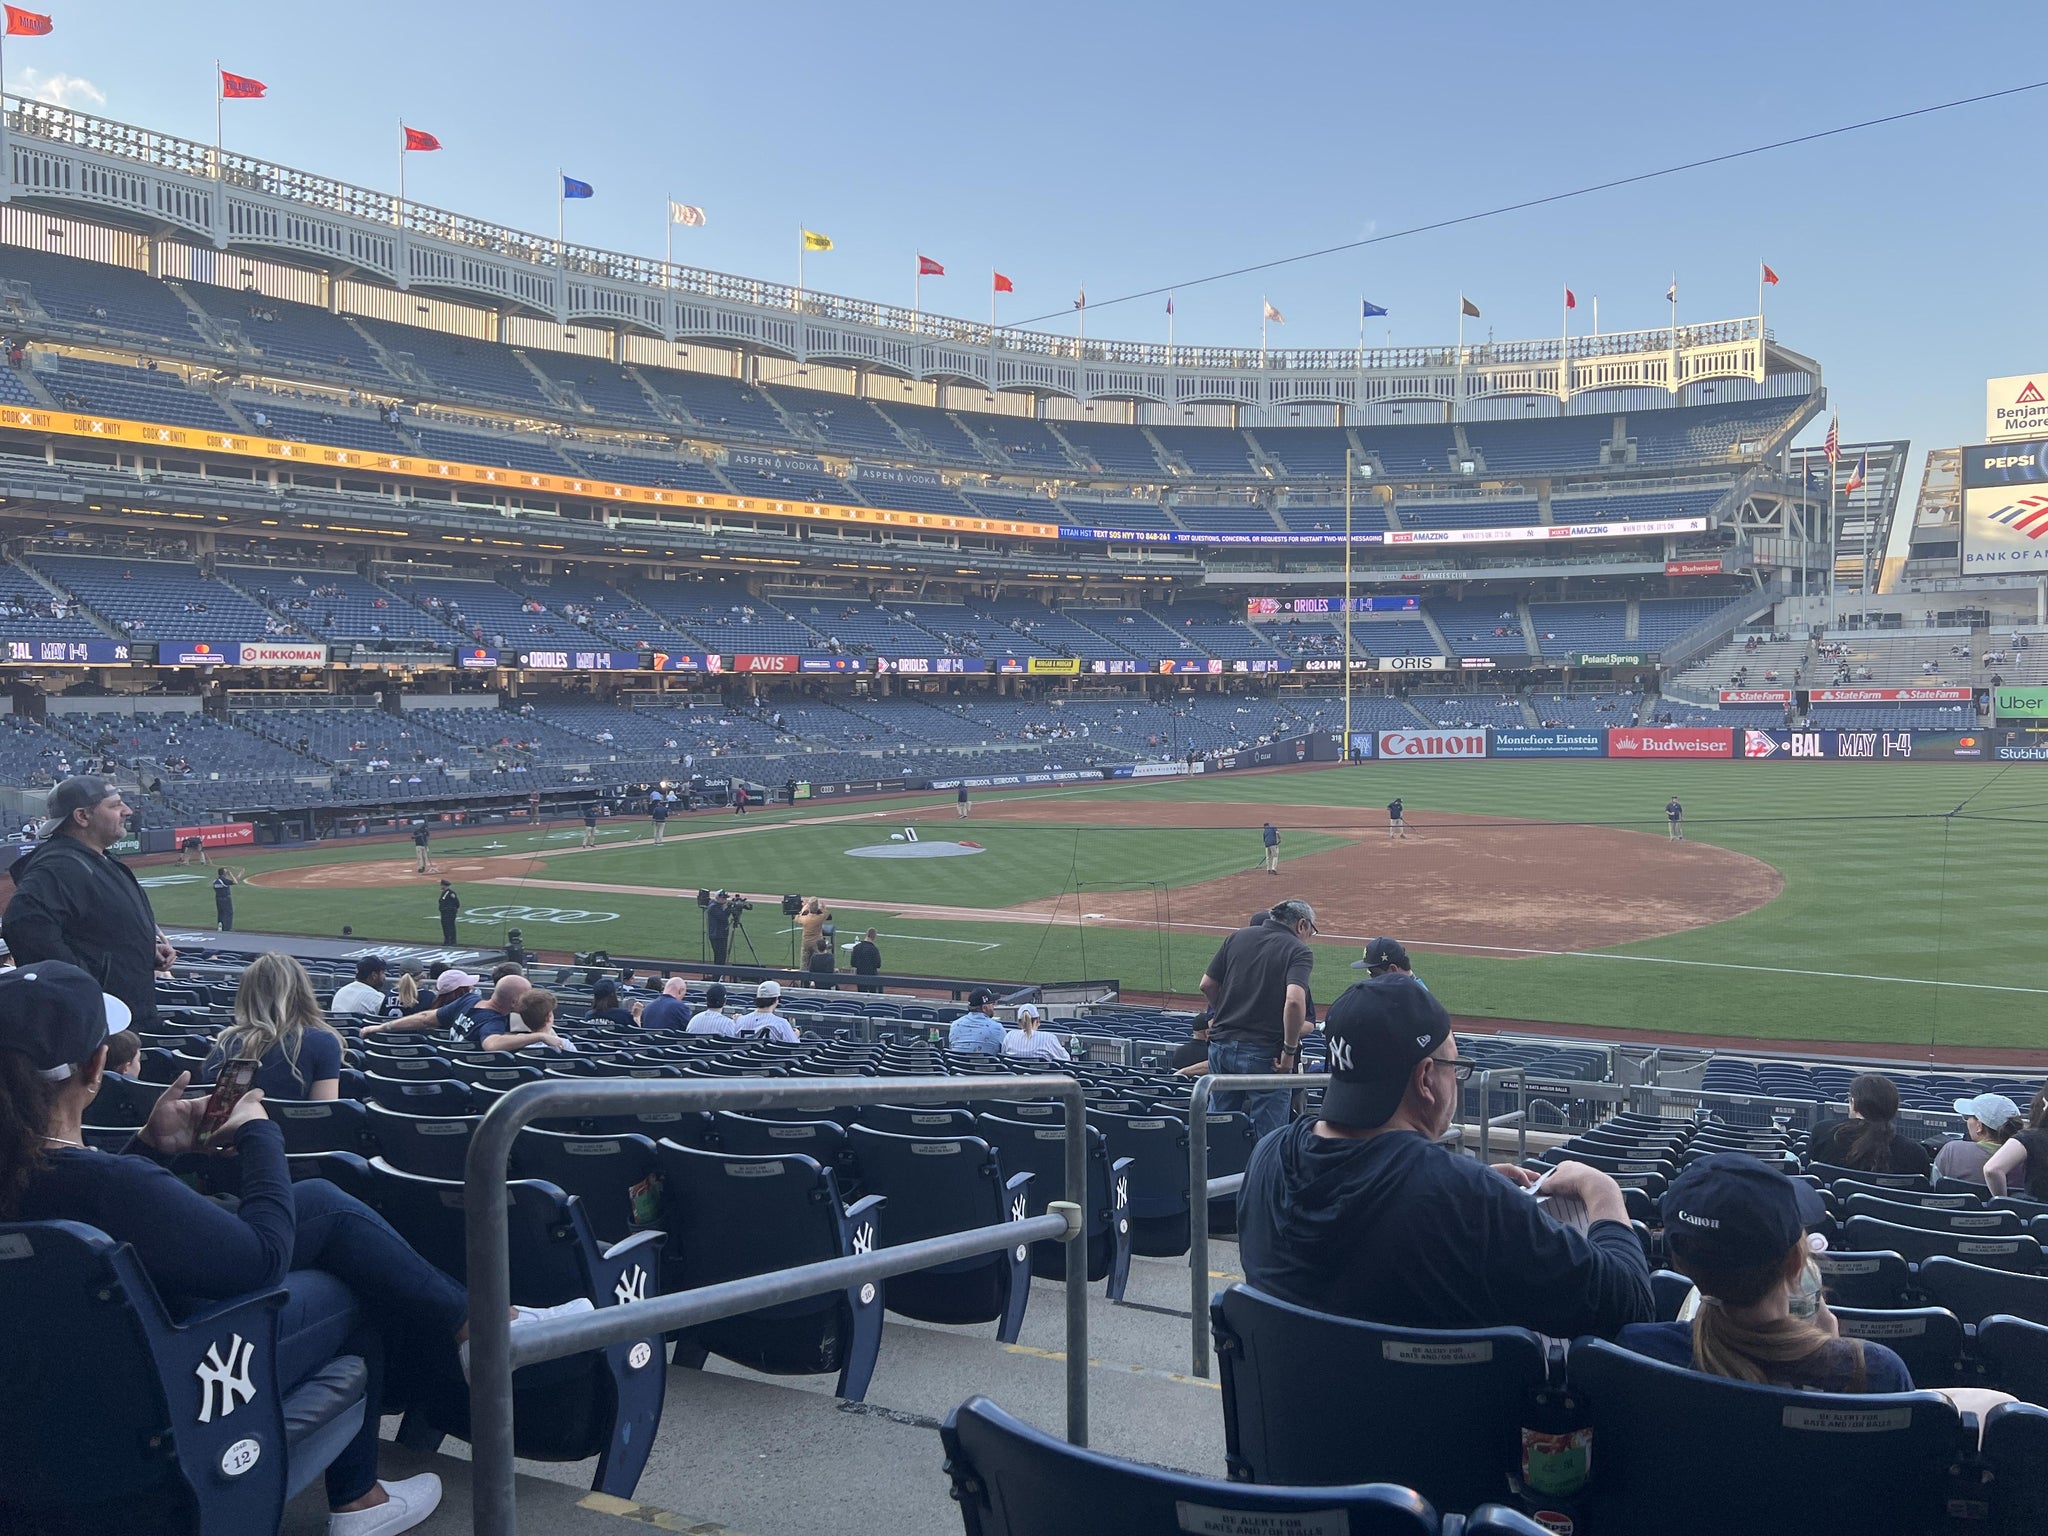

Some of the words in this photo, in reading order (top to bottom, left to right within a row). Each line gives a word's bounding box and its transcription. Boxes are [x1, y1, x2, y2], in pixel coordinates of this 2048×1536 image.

[735, 454, 771, 466] ASPEN
[785, 460, 819, 471] VODKA
[1985, 455, 2035, 469] PEPSI
[863, 470, 895, 480] ASPEN
[906, 474, 937, 485] VODKA
[1060, 528, 1079, 536] TITAN
[1080, 529, 1092, 537] HST
[1093, 530, 1108, 538] TEXT
[1109, 531, 1121, 539] SOS
[1413, 533, 1449, 541] AMAZING
[1571, 527, 1608, 535] AMAZING
[1966, 552, 2006, 562] BANK
[2011, 551, 2029, 559] OF
[1682, 565, 1719, 573] Budweiser
[1294, 598, 1328, 612] ORIOLES
[41, 643, 66, 660] MAY
[69, 643, 87, 660] 1-4
[115, 646, 128, 658] NY
[260, 650, 321, 660] KIKKOMAN
[529, 651, 567, 668] ORIOLES
[576, 652, 595, 668] MAY
[749, 657, 784, 670] AVIS
[899, 658, 928, 672] ORIOLES
[1095, 660, 1106, 672] BAL
[1236, 660, 1248, 672] BAL
[1306, 661, 1326, 669] 6:24
[1327, 661, 1341, 669] PM
[1391, 657, 1432, 669] ORIS
[1582, 655, 1610, 664] Poland
[1610, 654, 1639, 665] Spring
[2000, 696, 2043, 709] Uber
[1380, 734, 1484, 756] Canon
[1496, 734, 1554, 745] Montefiore
[1556, 734, 1598, 744] Einstein
[1642, 738, 1725, 751] Budweiser
[1791, 733, 1824, 756] BAL
[1838, 733, 1876, 757] MAY
[1881, 733, 1911, 757] 1-4
[207, 832, 238, 840] AMERICA
[1329, 1035, 1354, 1070] NY
[1116, 1176, 1127, 1210] NY
[1678, 1210, 1719, 1228] Canon
[864, 1290, 872, 1300] 10
[636, 1352, 646, 1364] 11
[196, 1333, 256, 1423] NY
[233, 1451, 251, 1469] 12
[1222, 1515, 1235, 1523] BE
[1241, 1517, 1274, 1526] ALERT
[1280, 1519, 1302, 1527] FOR
[1204, 1521, 1233, 1534] BATS
[1236, 1527, 1282, 1536] AND/OR
[1287, 1526, 1322, 1536] BALLS
